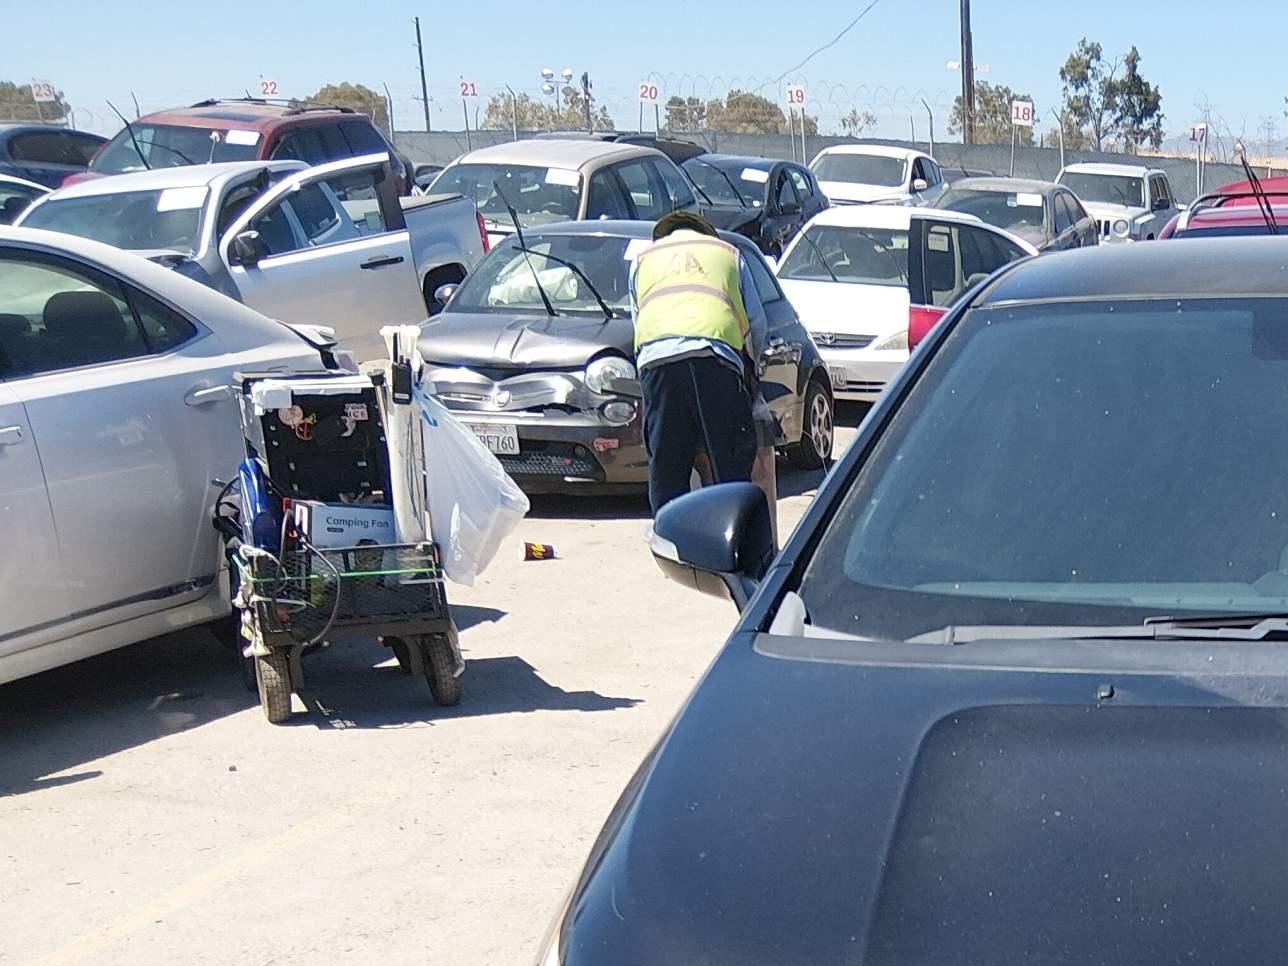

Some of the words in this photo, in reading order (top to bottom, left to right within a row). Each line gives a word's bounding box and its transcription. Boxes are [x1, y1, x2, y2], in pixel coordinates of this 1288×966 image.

[34, 83, 51, 97] 23
[261, 81, 278, 95] 22
[460, 82, 478, 97] 21
[640, 84, 658, 100] 20
[787, 89, 804, 104] 19
[1013, 106, 1031, 121] 18
[1189, 127, 1205, 142] 17
[326, 516, 369, 529] Camping
[371, 519, 389, 528] Fan
